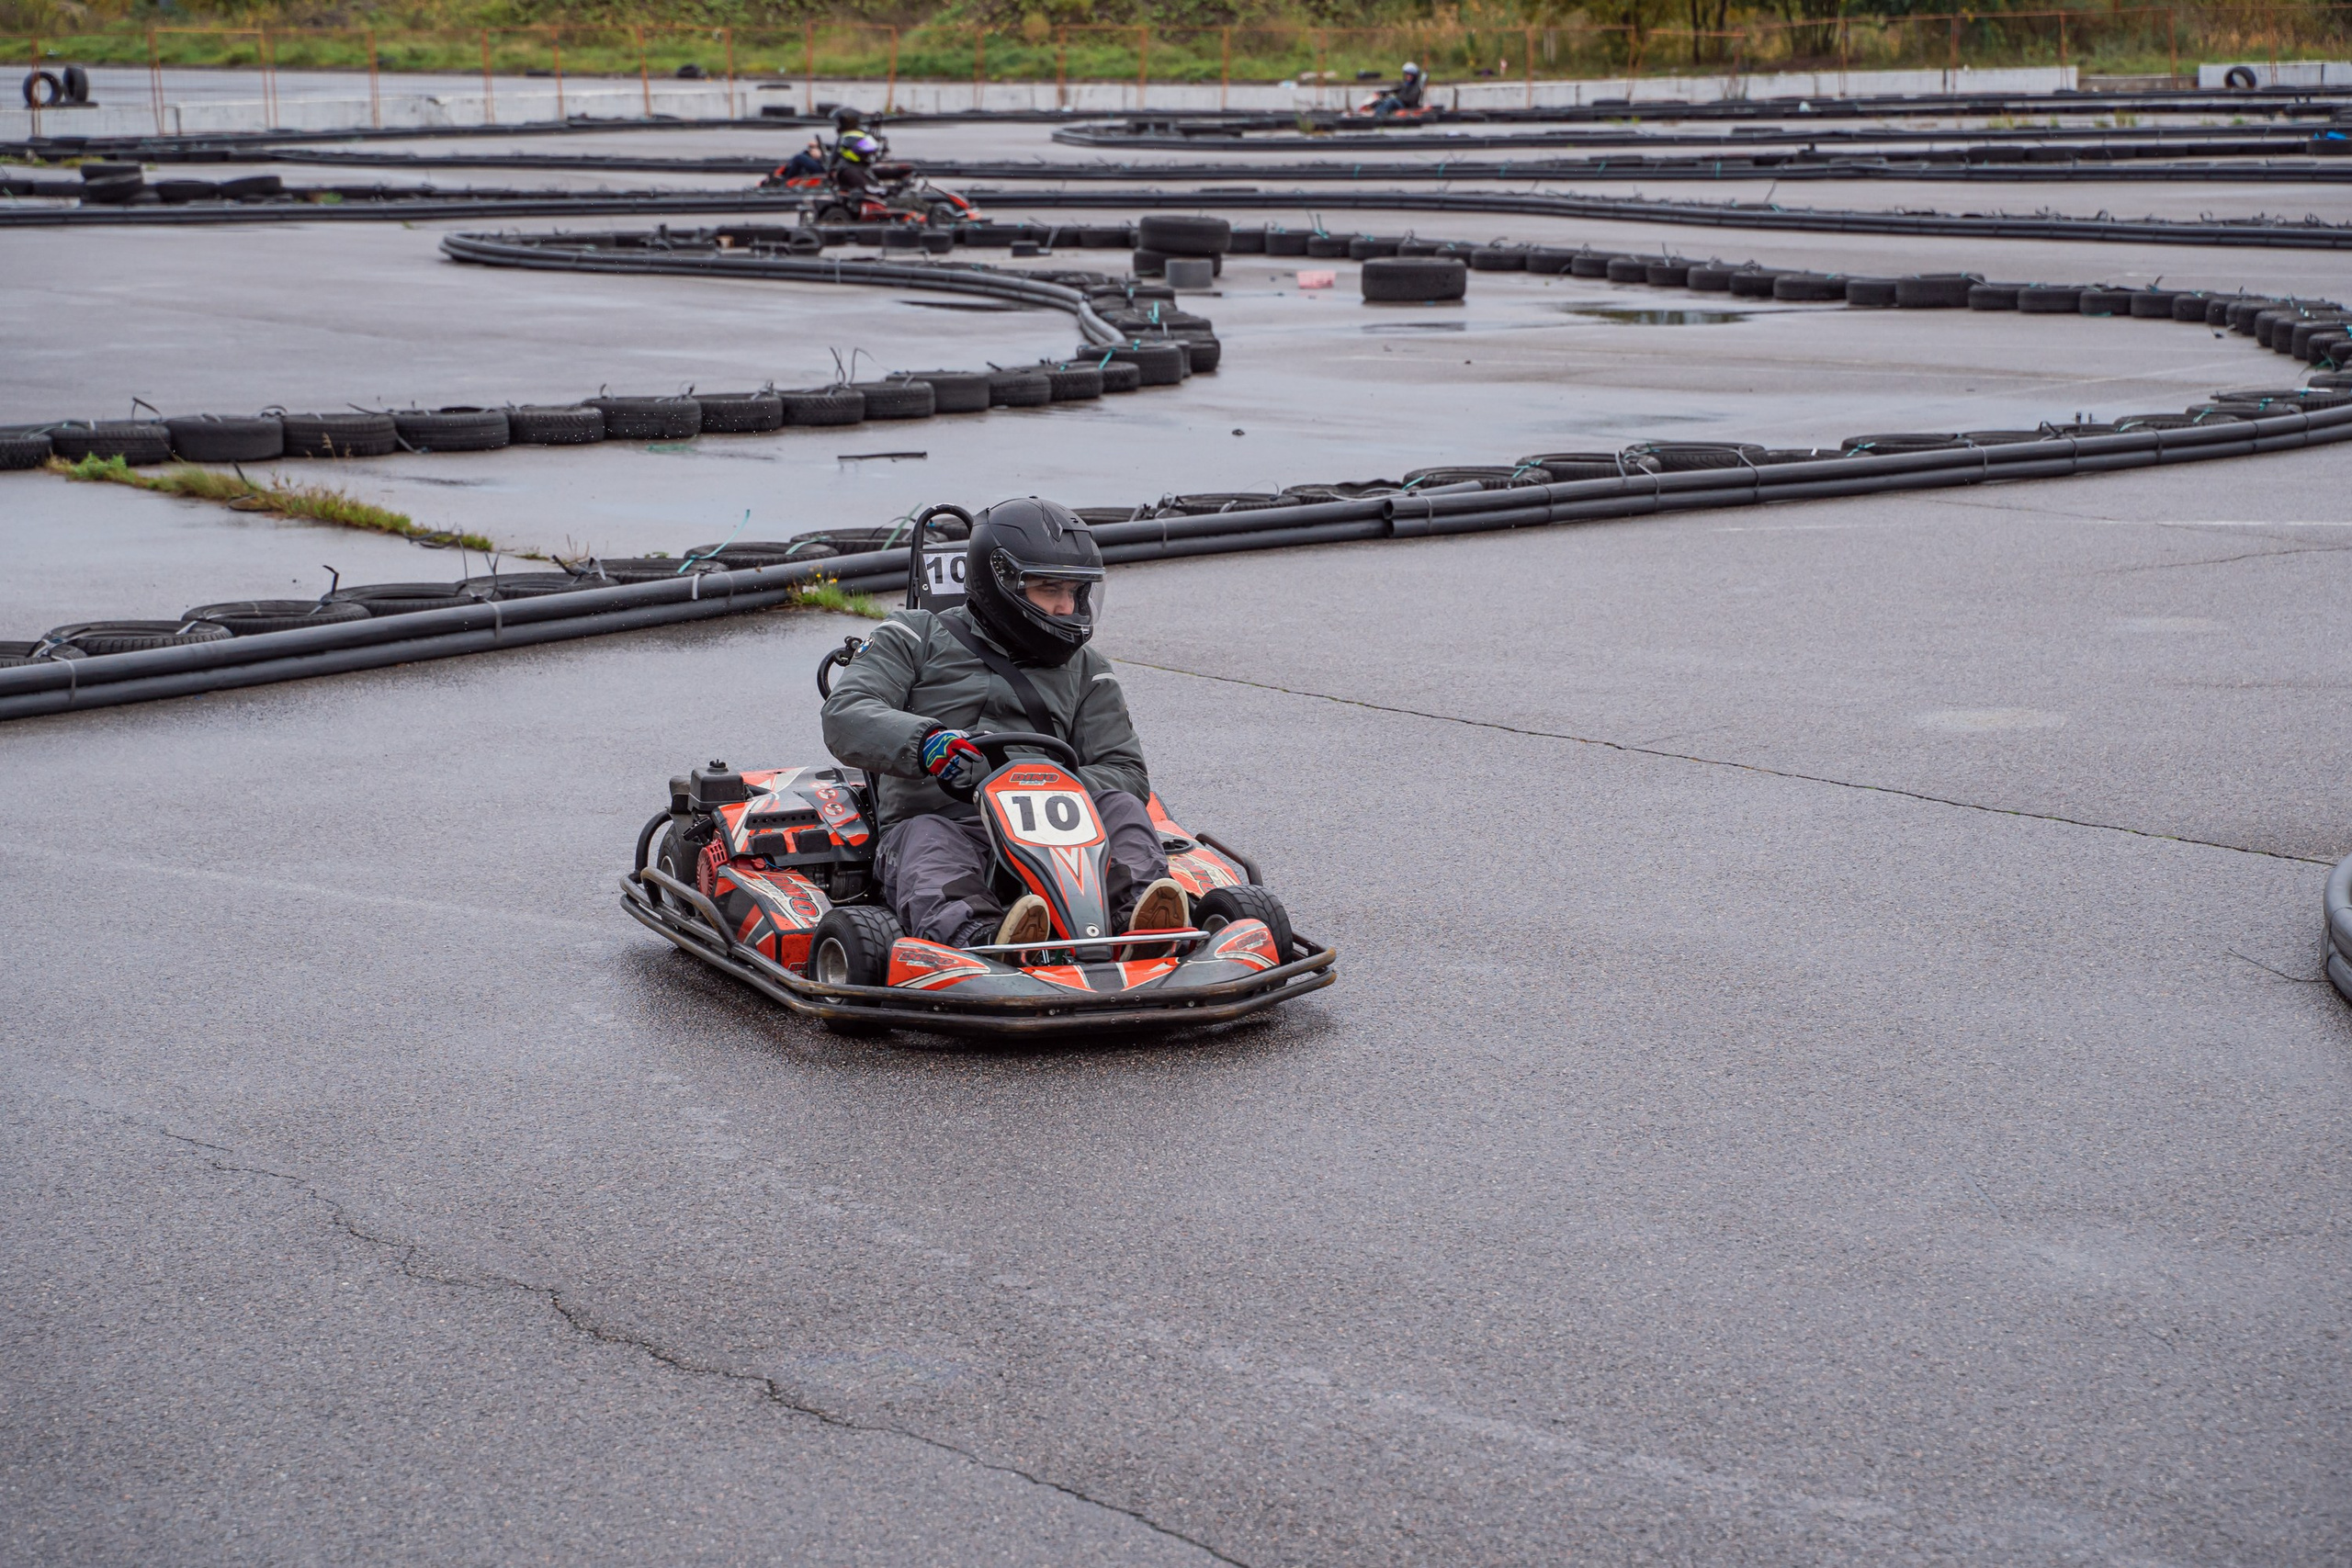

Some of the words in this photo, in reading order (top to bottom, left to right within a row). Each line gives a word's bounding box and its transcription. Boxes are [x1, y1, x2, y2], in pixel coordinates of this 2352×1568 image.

[926, 556, 967, 583] 10
[1009, 773, 1059, 783] DINO
[1011, 795, 1080, 831] 10
[1234, 931, 1268, 949] DINO
[898, 952, 956, 966] DINO
